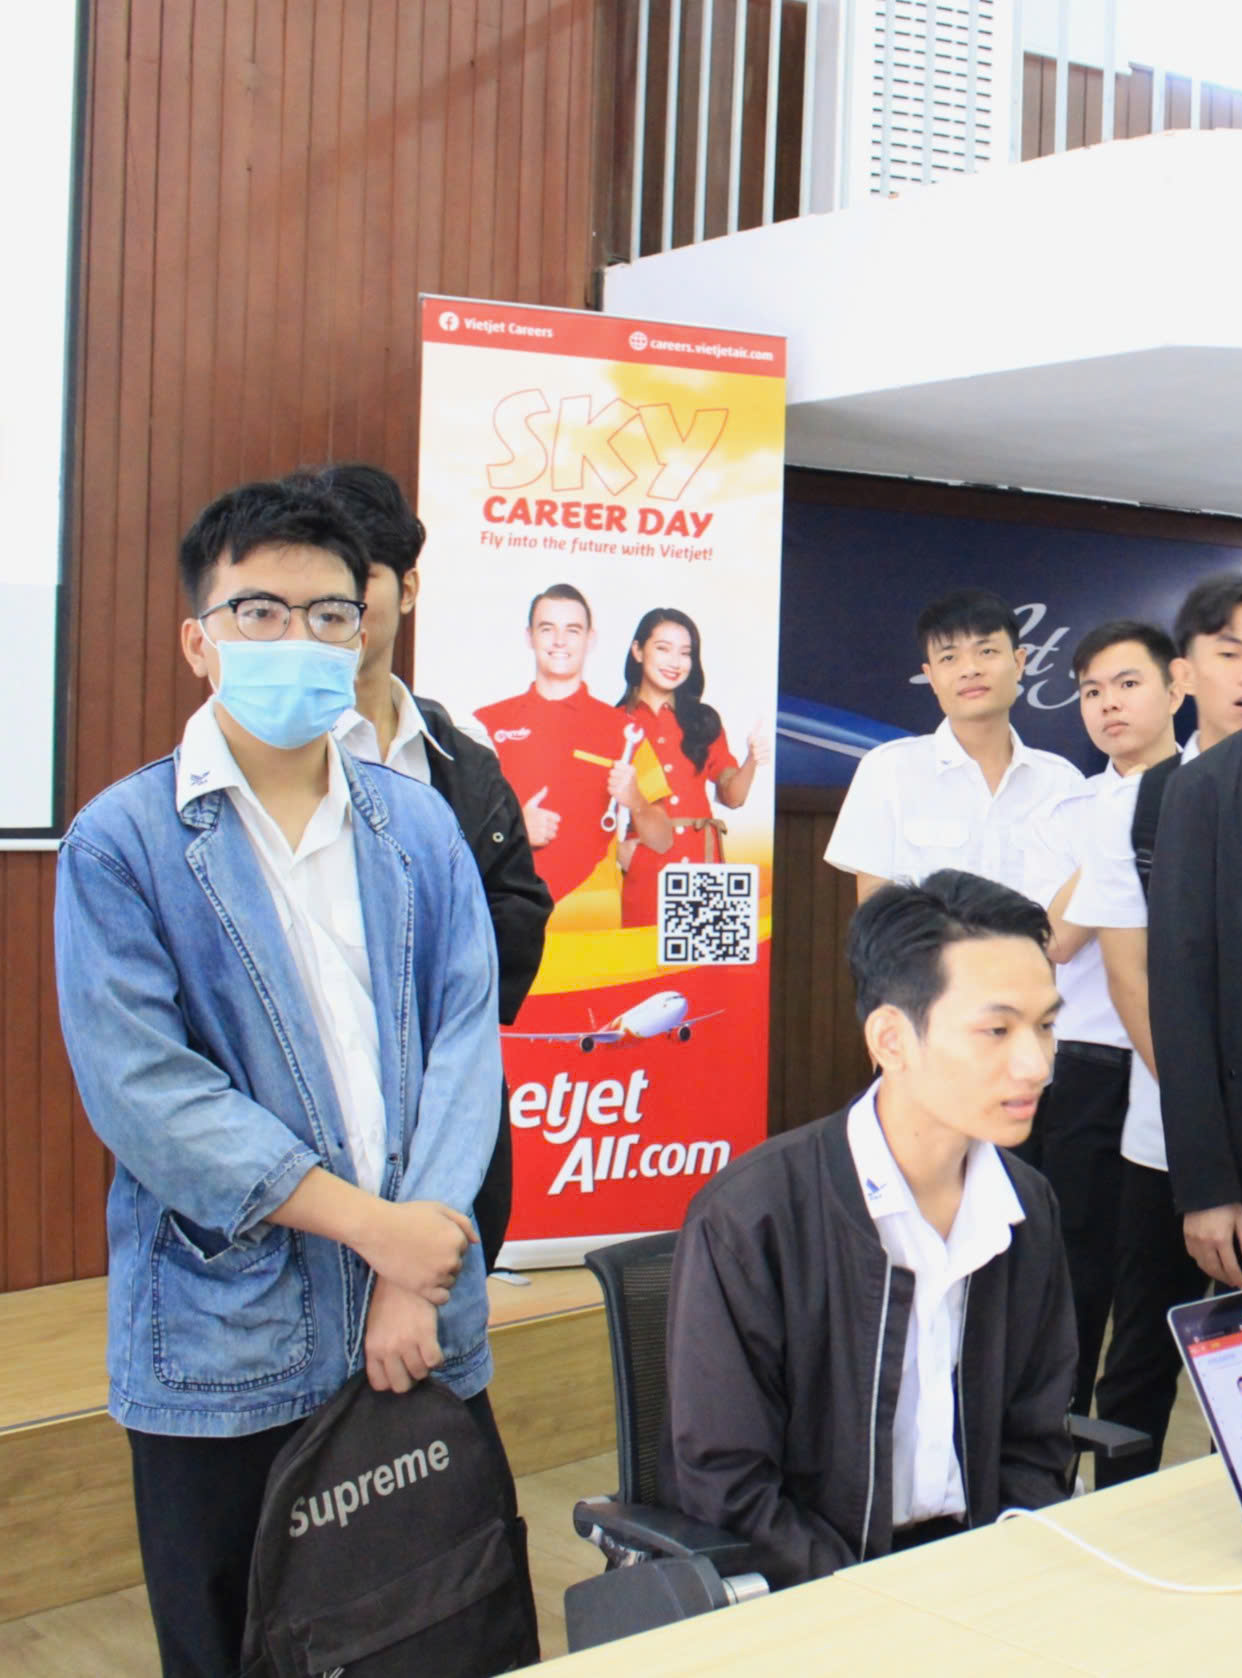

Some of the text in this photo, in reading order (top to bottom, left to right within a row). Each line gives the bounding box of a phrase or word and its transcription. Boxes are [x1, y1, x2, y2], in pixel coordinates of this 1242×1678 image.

[464, 317, 554, 338] Vietjet Careers
[650, 338, 774, 361] careers.vietjetair.com
[486, 388, 729, 501] SKY
[483, 495, 714, 539] CAREER DAY
[480, 530, 714, 563] Fly into the future with Vietjet!
[508, 1069, 649, 1145] etjet
[289, 1439, 450, 1538] Supreme
